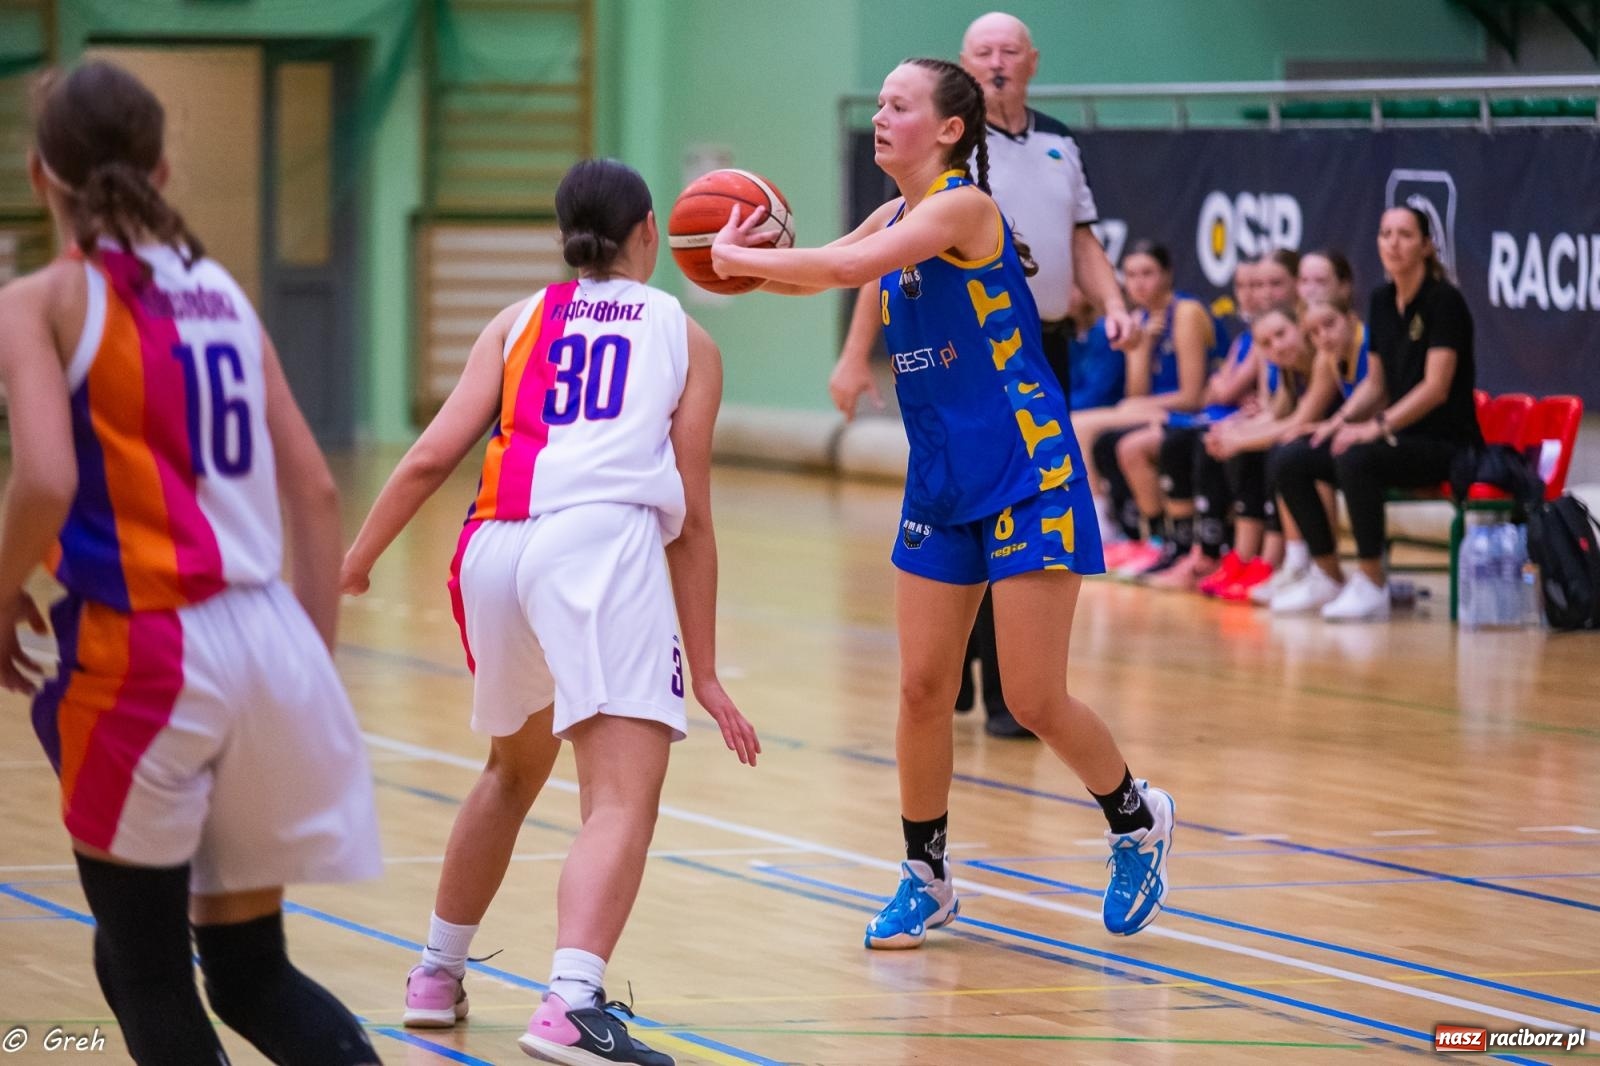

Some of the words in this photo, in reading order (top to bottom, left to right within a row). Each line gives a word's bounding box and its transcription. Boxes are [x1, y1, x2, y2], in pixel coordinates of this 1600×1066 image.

[550, 299, 645, 323] RACIBÓRZ
[881, 289, 890, 326] 8
[541, 332, 631, 425] 30
[171, 342, 254, 479] 16
[990, 542, 1027, 560] regio
[671, 646, 685, 699] 3
